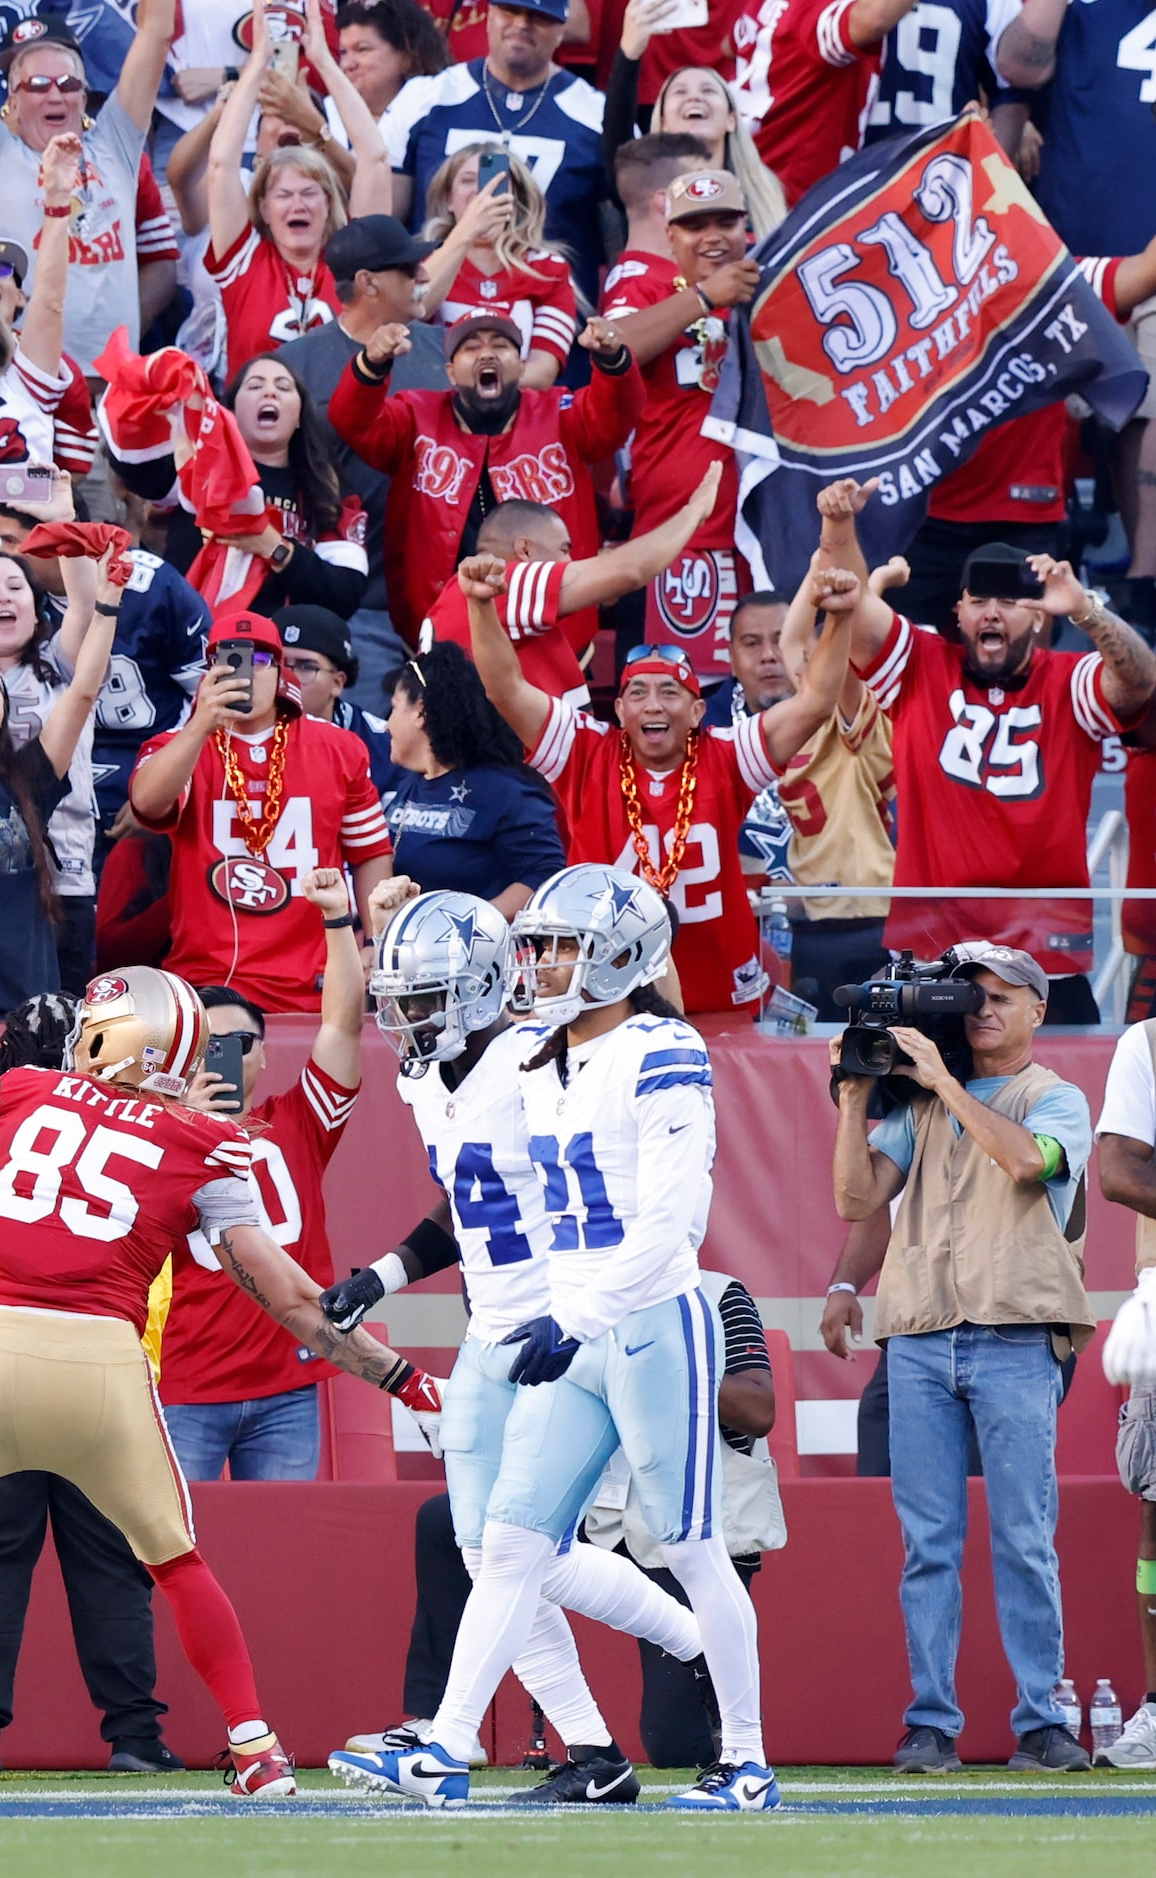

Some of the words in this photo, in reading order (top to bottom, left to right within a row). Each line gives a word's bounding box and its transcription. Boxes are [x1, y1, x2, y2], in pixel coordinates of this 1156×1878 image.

[797, 152, 996, 374] 512
[877, 448, 942, 505] SAN
[1044, 303, 1088, 354] TX
[939, 689, 1044, 799] 85
[213, 797, 319, 897] 54
[231, 863, 277, 907] SF
[93, 978, 119, 1002] SF
[52, 1076, 164, 1129] KITTLE
